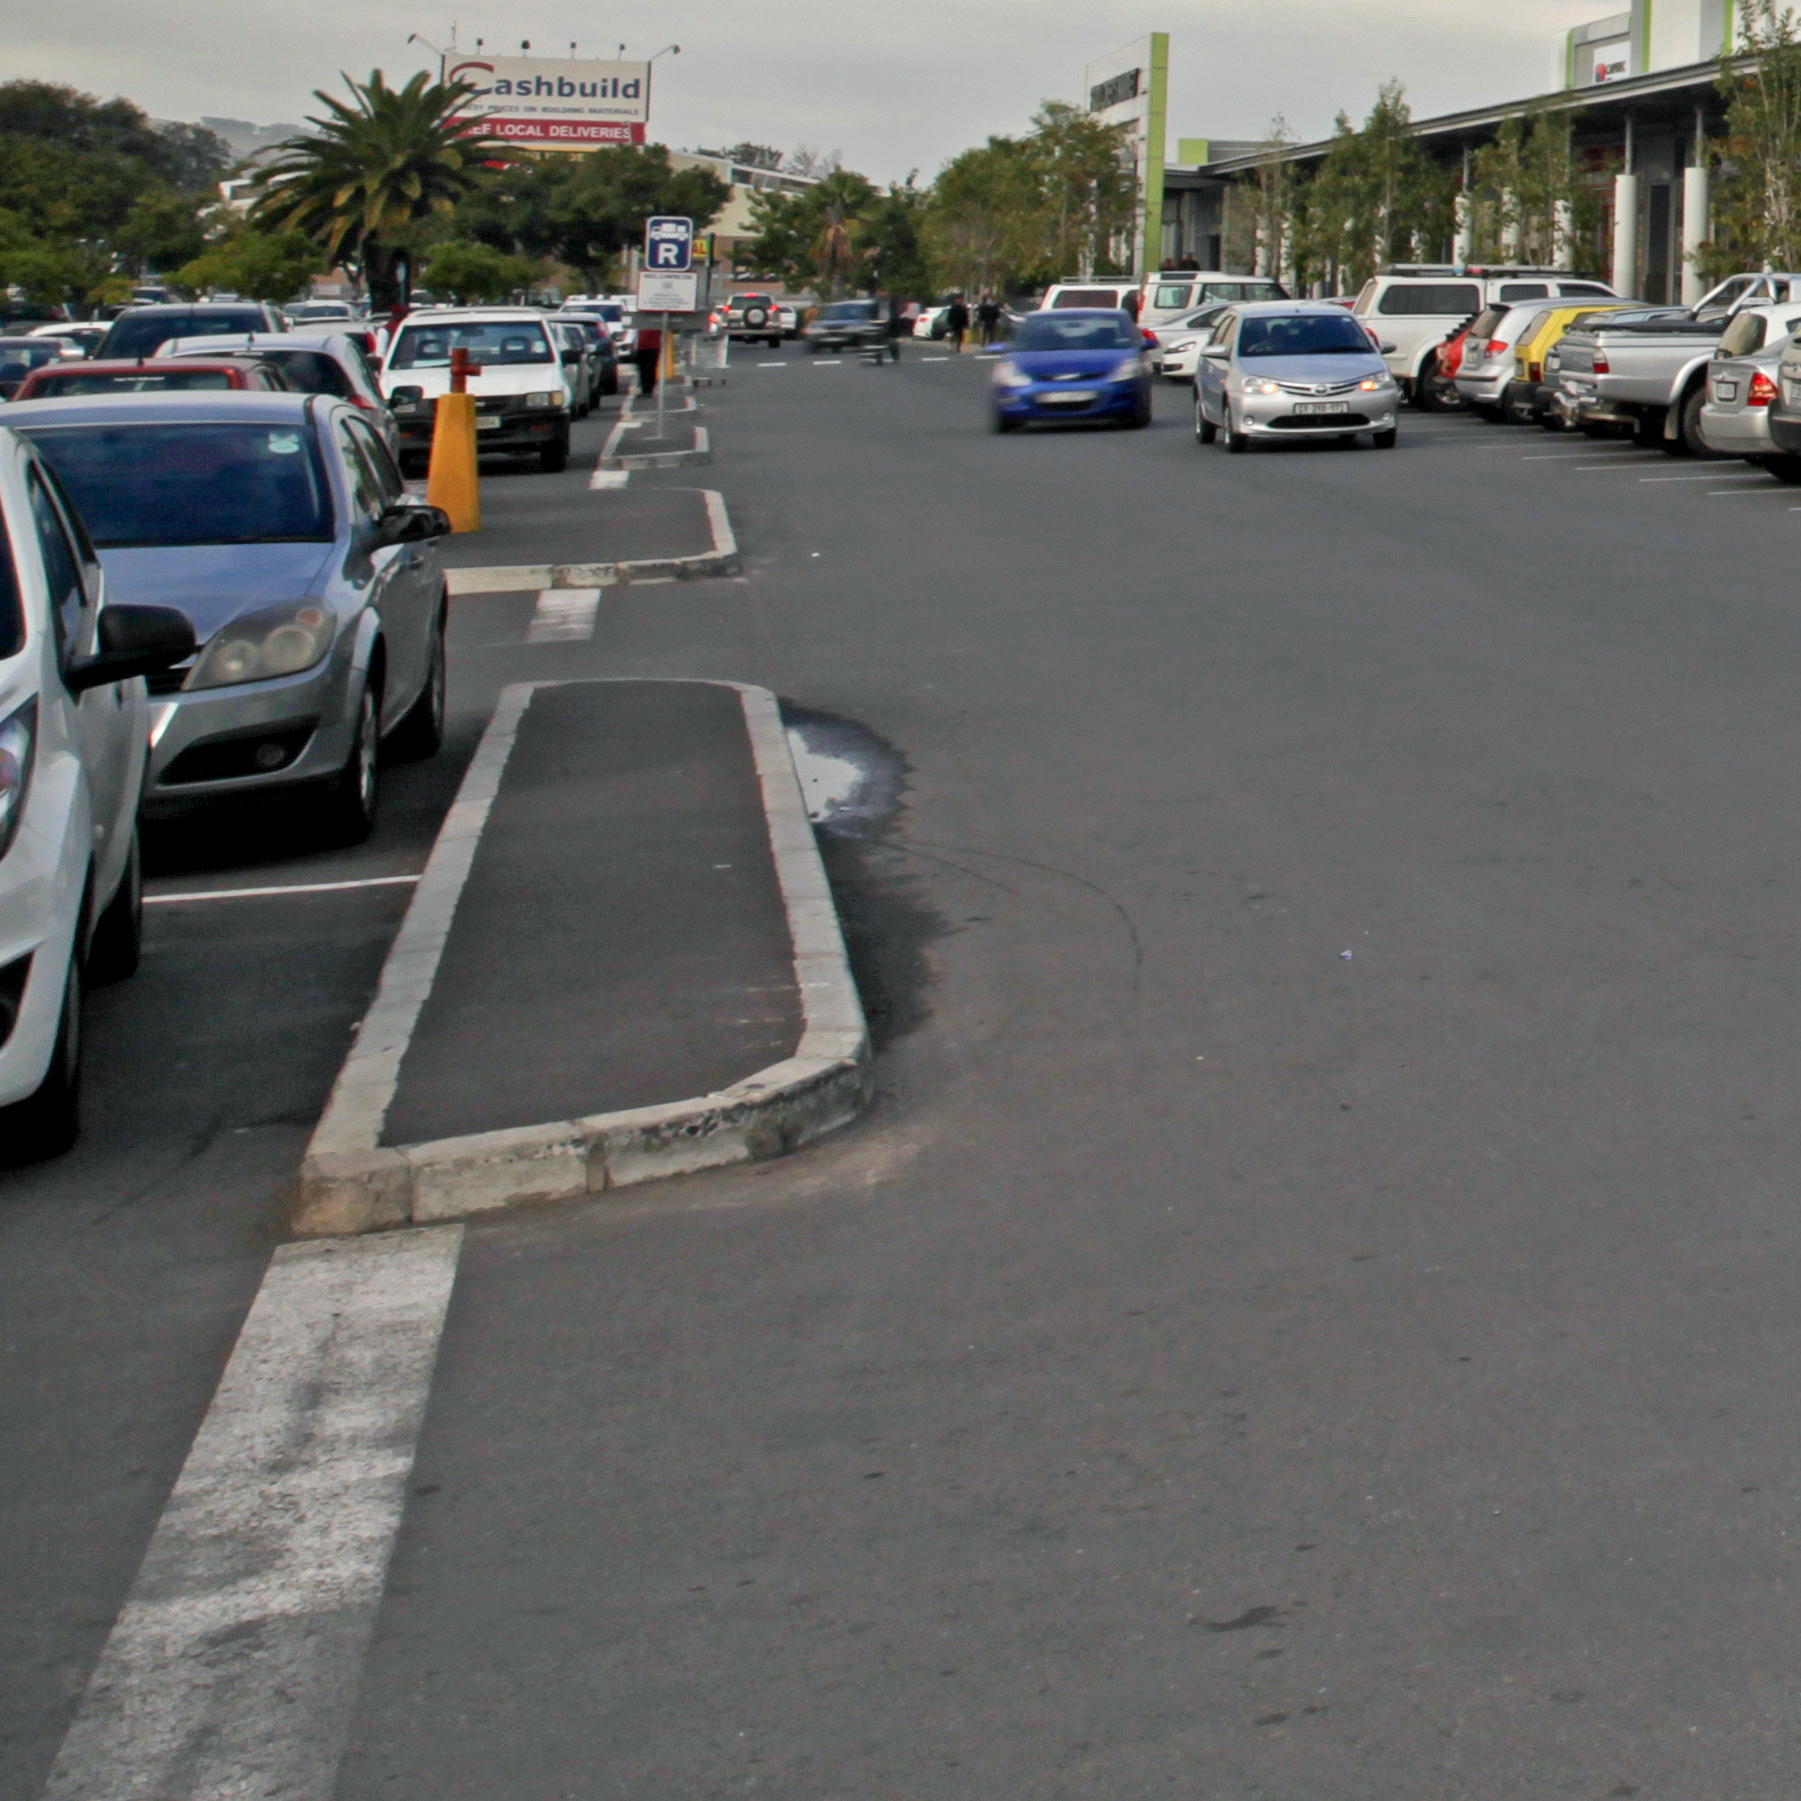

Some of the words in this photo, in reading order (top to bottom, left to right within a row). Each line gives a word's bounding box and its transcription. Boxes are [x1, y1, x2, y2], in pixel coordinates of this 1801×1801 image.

[449, 62, 640, 99] Cashbuild
[541, 106, 585, 114] BUILDING
[588, 106, 640, 115] MATERIALS
[496, 123, 545, 136] LOCAL
[549, 125, 632, 139] DELIVERIES
[657, 242, 680, 265] R
